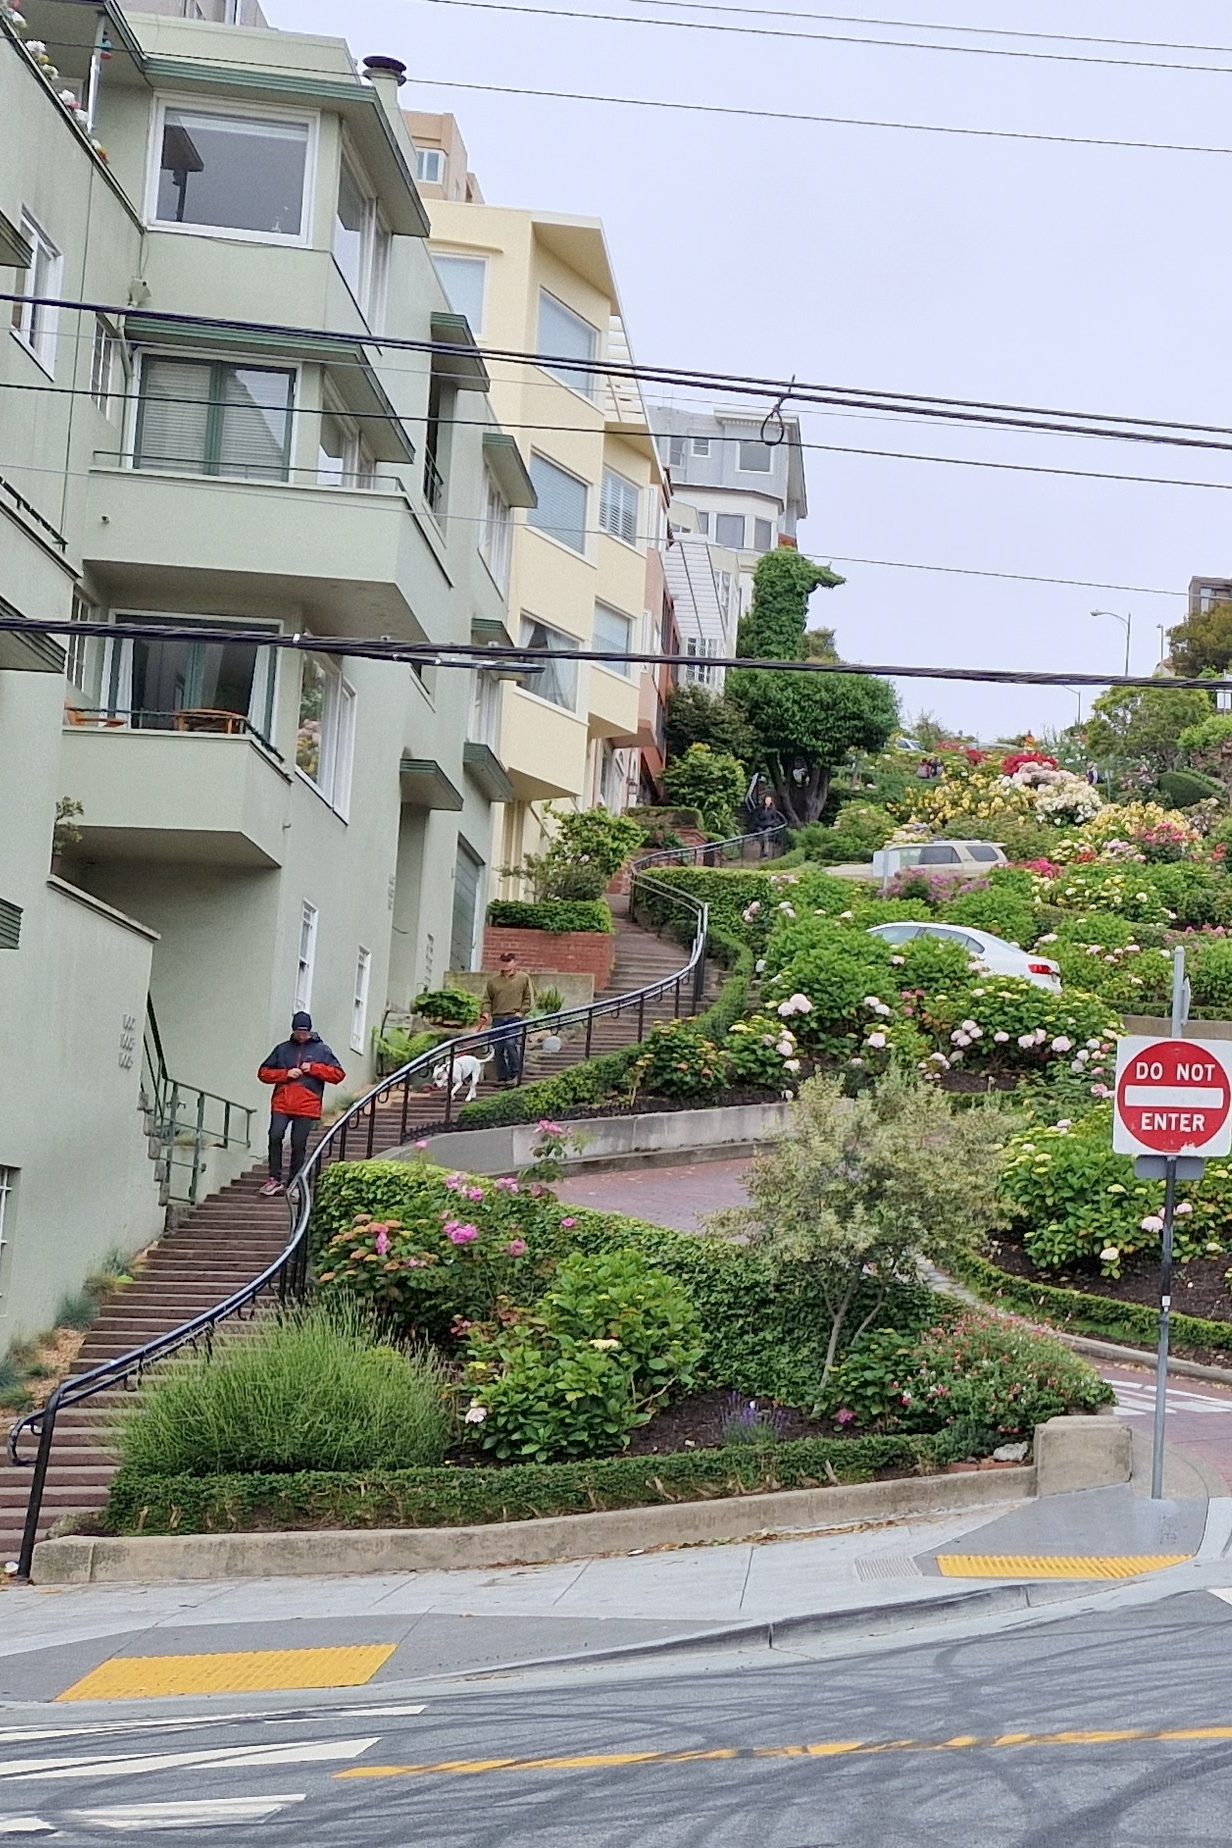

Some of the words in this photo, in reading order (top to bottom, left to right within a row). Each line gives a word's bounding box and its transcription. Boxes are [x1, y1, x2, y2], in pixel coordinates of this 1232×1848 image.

[1136, 1062, 1163, 1080] DO
[1176, 1063, 1216, 1082] NOT
[1141, 1112, 1205, 1132] ENTER
